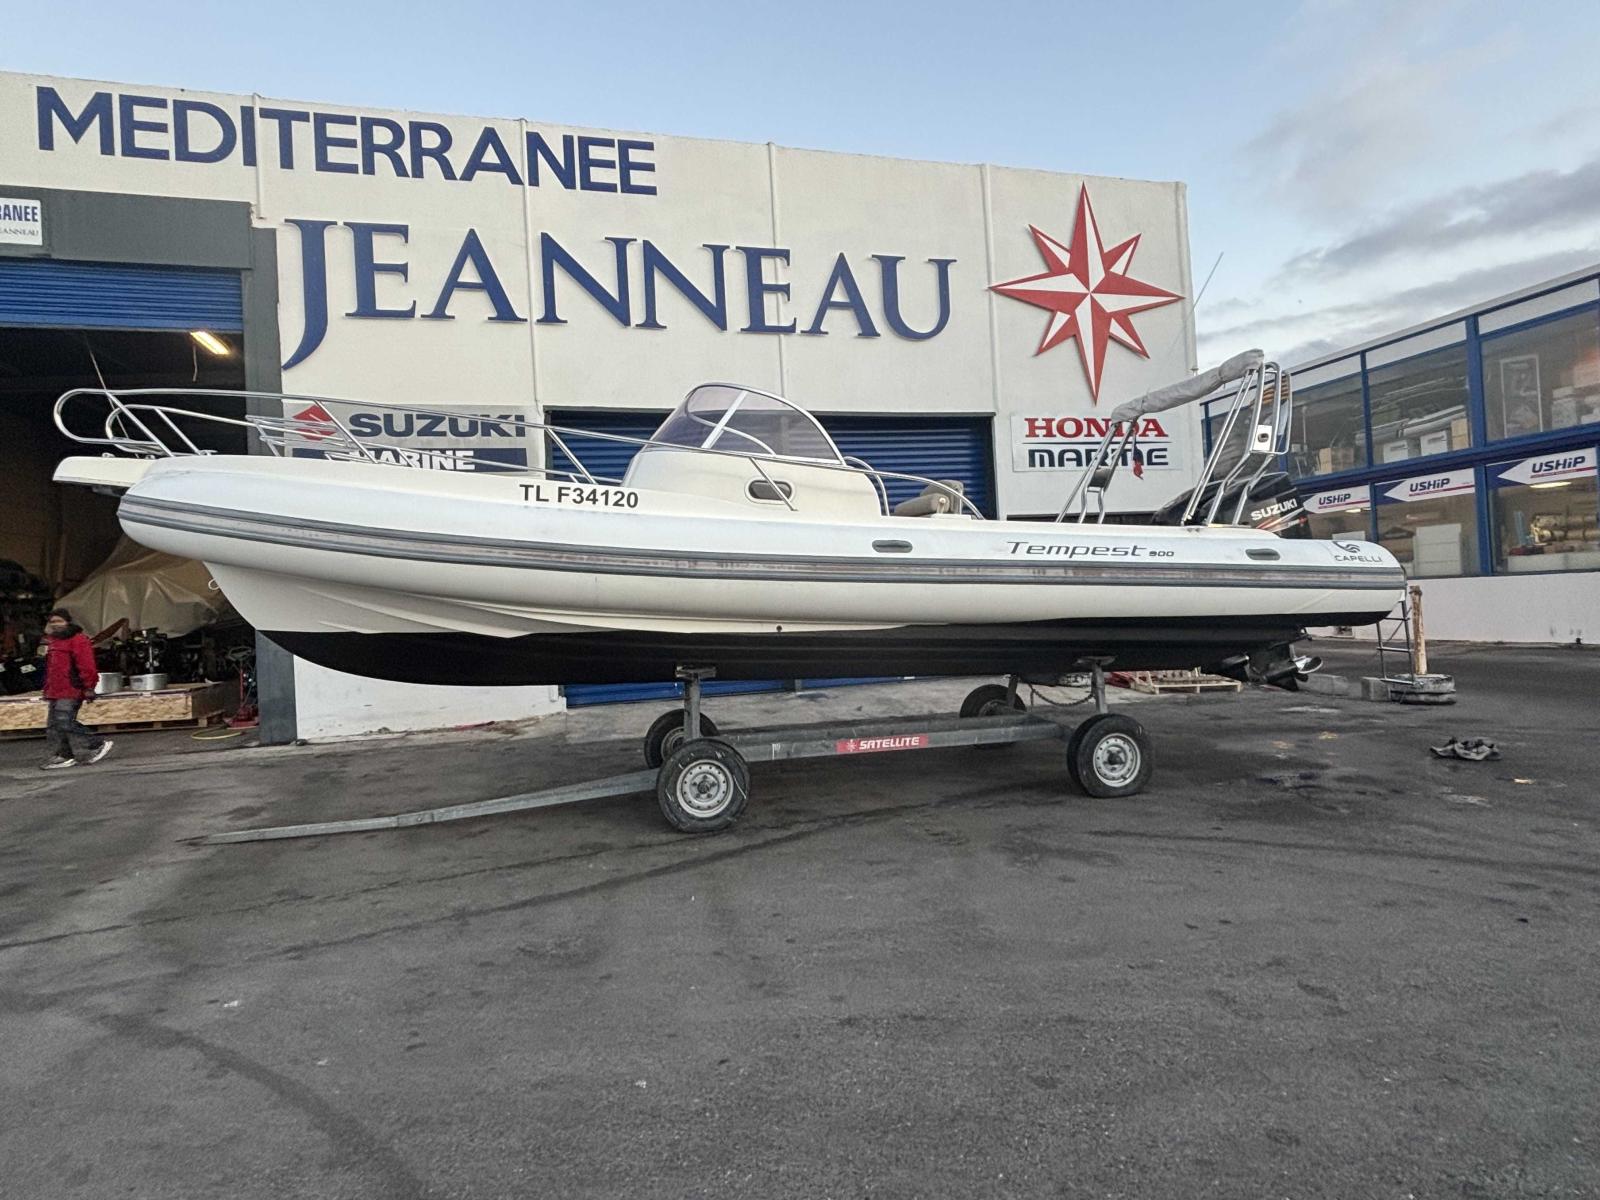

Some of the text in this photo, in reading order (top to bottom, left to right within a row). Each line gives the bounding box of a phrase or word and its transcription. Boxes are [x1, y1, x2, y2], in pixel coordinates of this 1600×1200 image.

[37, 86, 657, 196] MEDITERRANEE
[0, 204, 38, 222] ANEE
[281, 218, 957, 371] JEANNEAU
[349, 413, 525, 438] SUZUKI
[519, 484, 639, 508] TL F34120
[1250, 498, 1298, 520] SUZUKI
[1007, 541, 1147, 558] Tempest
[859, 736, 920, 750] SATELLITE
